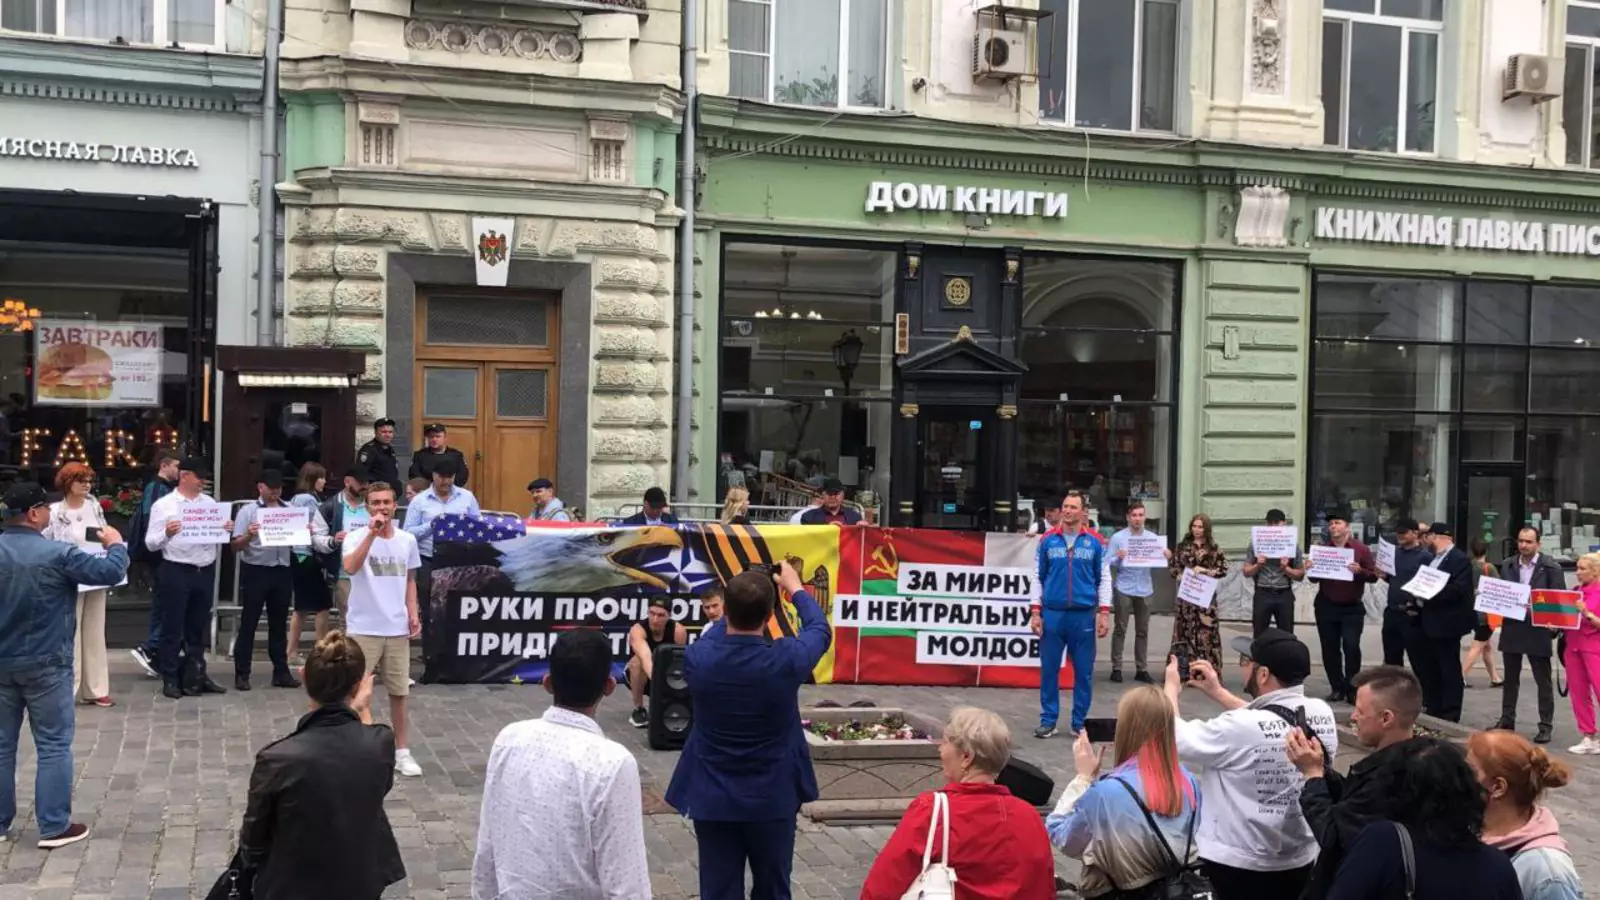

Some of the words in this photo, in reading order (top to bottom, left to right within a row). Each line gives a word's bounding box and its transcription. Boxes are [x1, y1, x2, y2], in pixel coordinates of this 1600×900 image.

[111, 145, 199, 166] ЛАВКА
[865, 181, 947, 212] ДОМ
[953, 186, 1068, 217] КНИГИ
[1315, 207, 1452, 246] КНИЖНАЯ
[1455, 217, 1543, 252] ЛАВКА
[1547, 224, 1600, 256] ПИС
[40, 327, 158, 348] ЗАВТРАКИ
[907, 570, 938, 590] ЗА
[946, 571, 1031, 595] МИРНУ
[460, 596, 544, 620] РУКИ
[842, 599, 859, 620] И
[868, 597, 1031, 626] НЕЙТРАЛЬНУ
[927, 636, 1041, 661] МОЛДОВ
